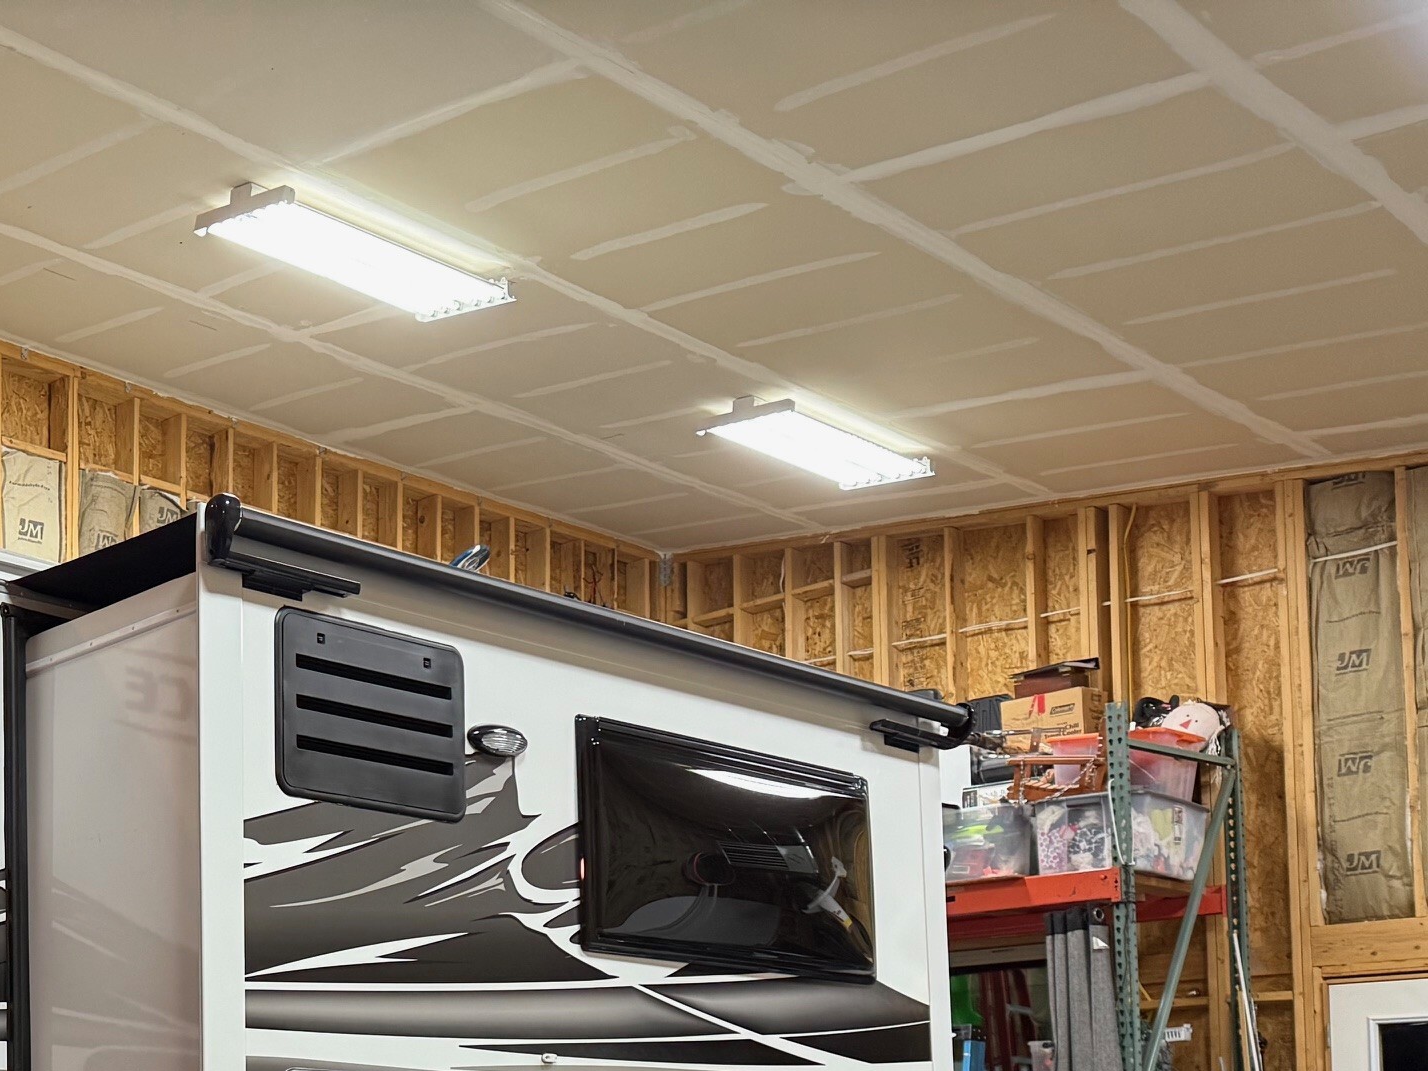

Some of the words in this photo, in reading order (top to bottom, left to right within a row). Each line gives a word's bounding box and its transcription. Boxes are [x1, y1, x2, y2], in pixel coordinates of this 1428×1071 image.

[19, 517, 44, 541] JM
[1334, 557, 1371, 580] JM
[1336, 648, 1371, 672] JM
[1337, 755, 1373, 777] JM
[1345, 850, 1381, 873] JM
